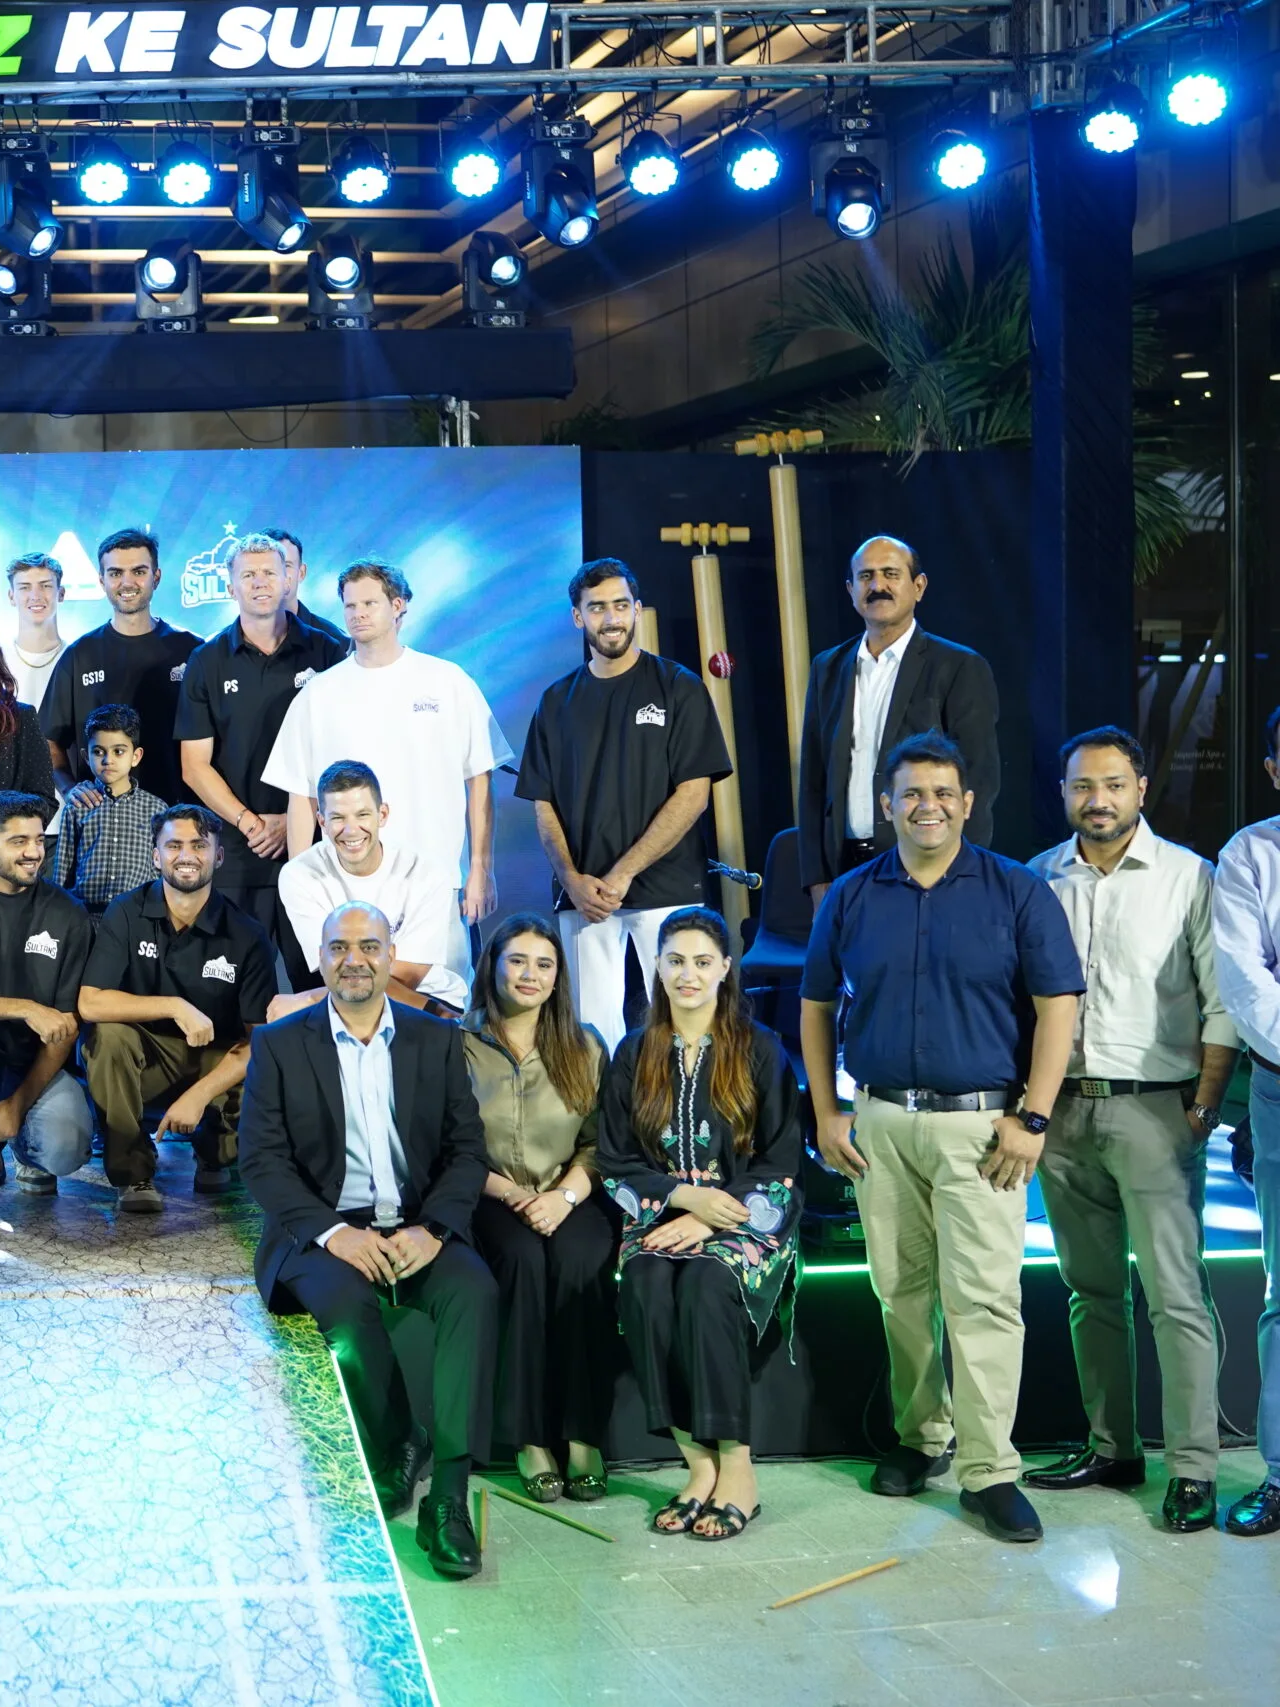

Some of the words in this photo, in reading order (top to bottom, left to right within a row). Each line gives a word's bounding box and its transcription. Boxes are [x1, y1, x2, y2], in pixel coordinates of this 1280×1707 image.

[55, 7, 184, 75] KE
[208, 1, 548, 71] SULTAN
[82, 670, 105, 686] GS19
[224, 679, 239, 694] PS
[25, 941, 57, 957] SULTANS
[203, 966, 234, 982] SULTANS
